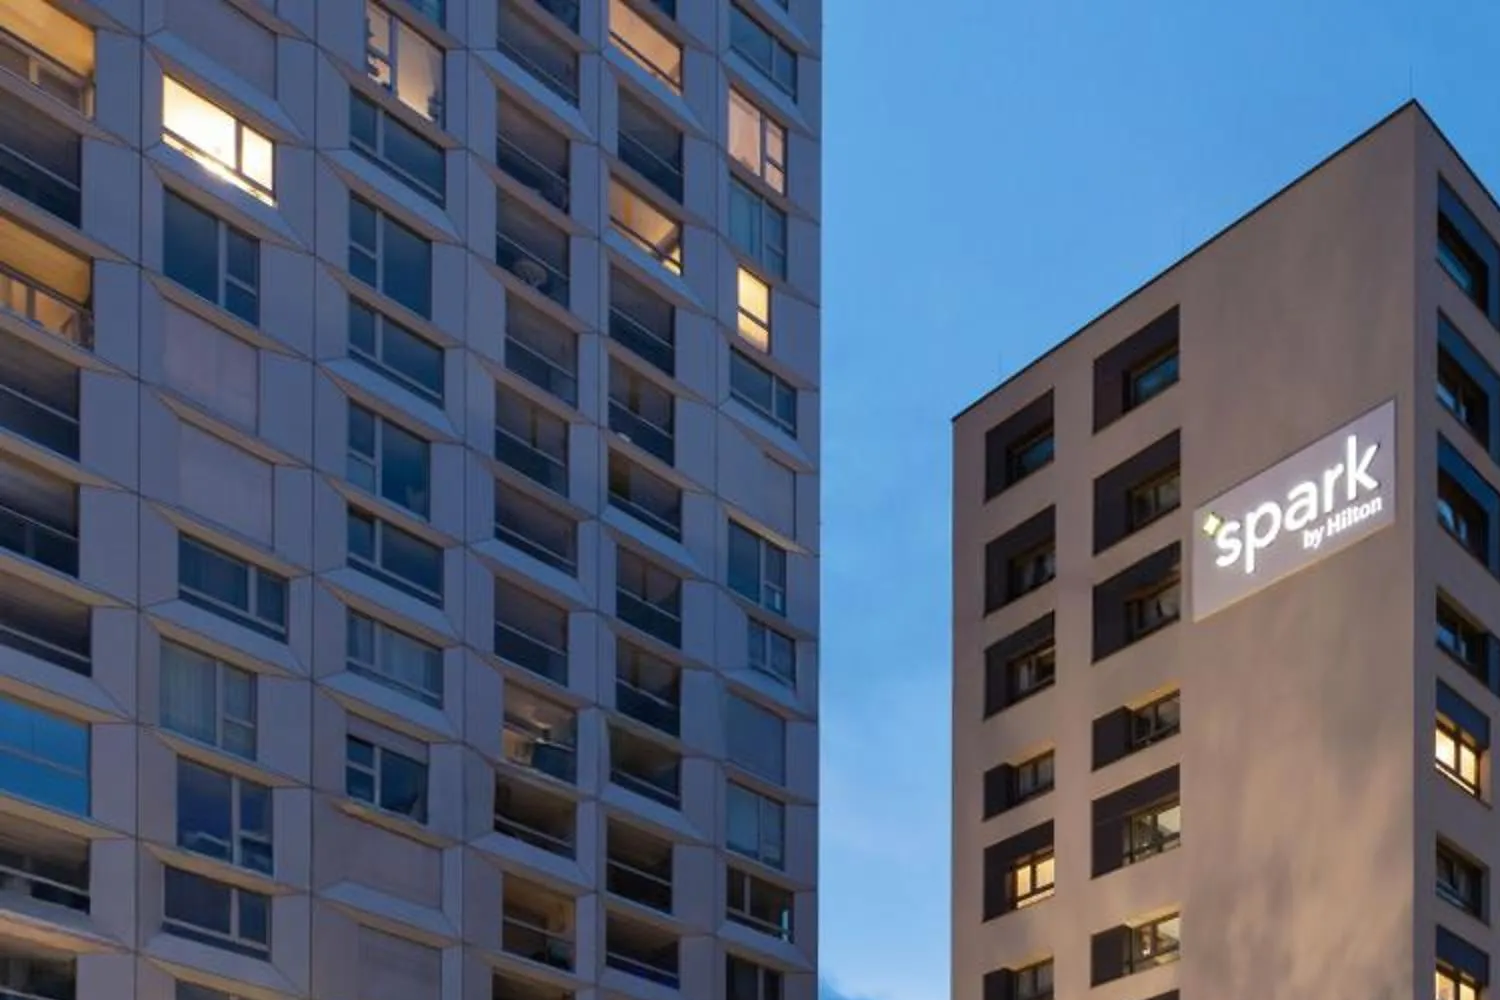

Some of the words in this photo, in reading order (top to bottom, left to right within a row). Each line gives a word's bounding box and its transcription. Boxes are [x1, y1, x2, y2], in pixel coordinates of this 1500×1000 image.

[1215, 434, 1380, 574] spark
[1302, 528, 1326, 550] by
[1326, 496, 1383, 538] Hilton
